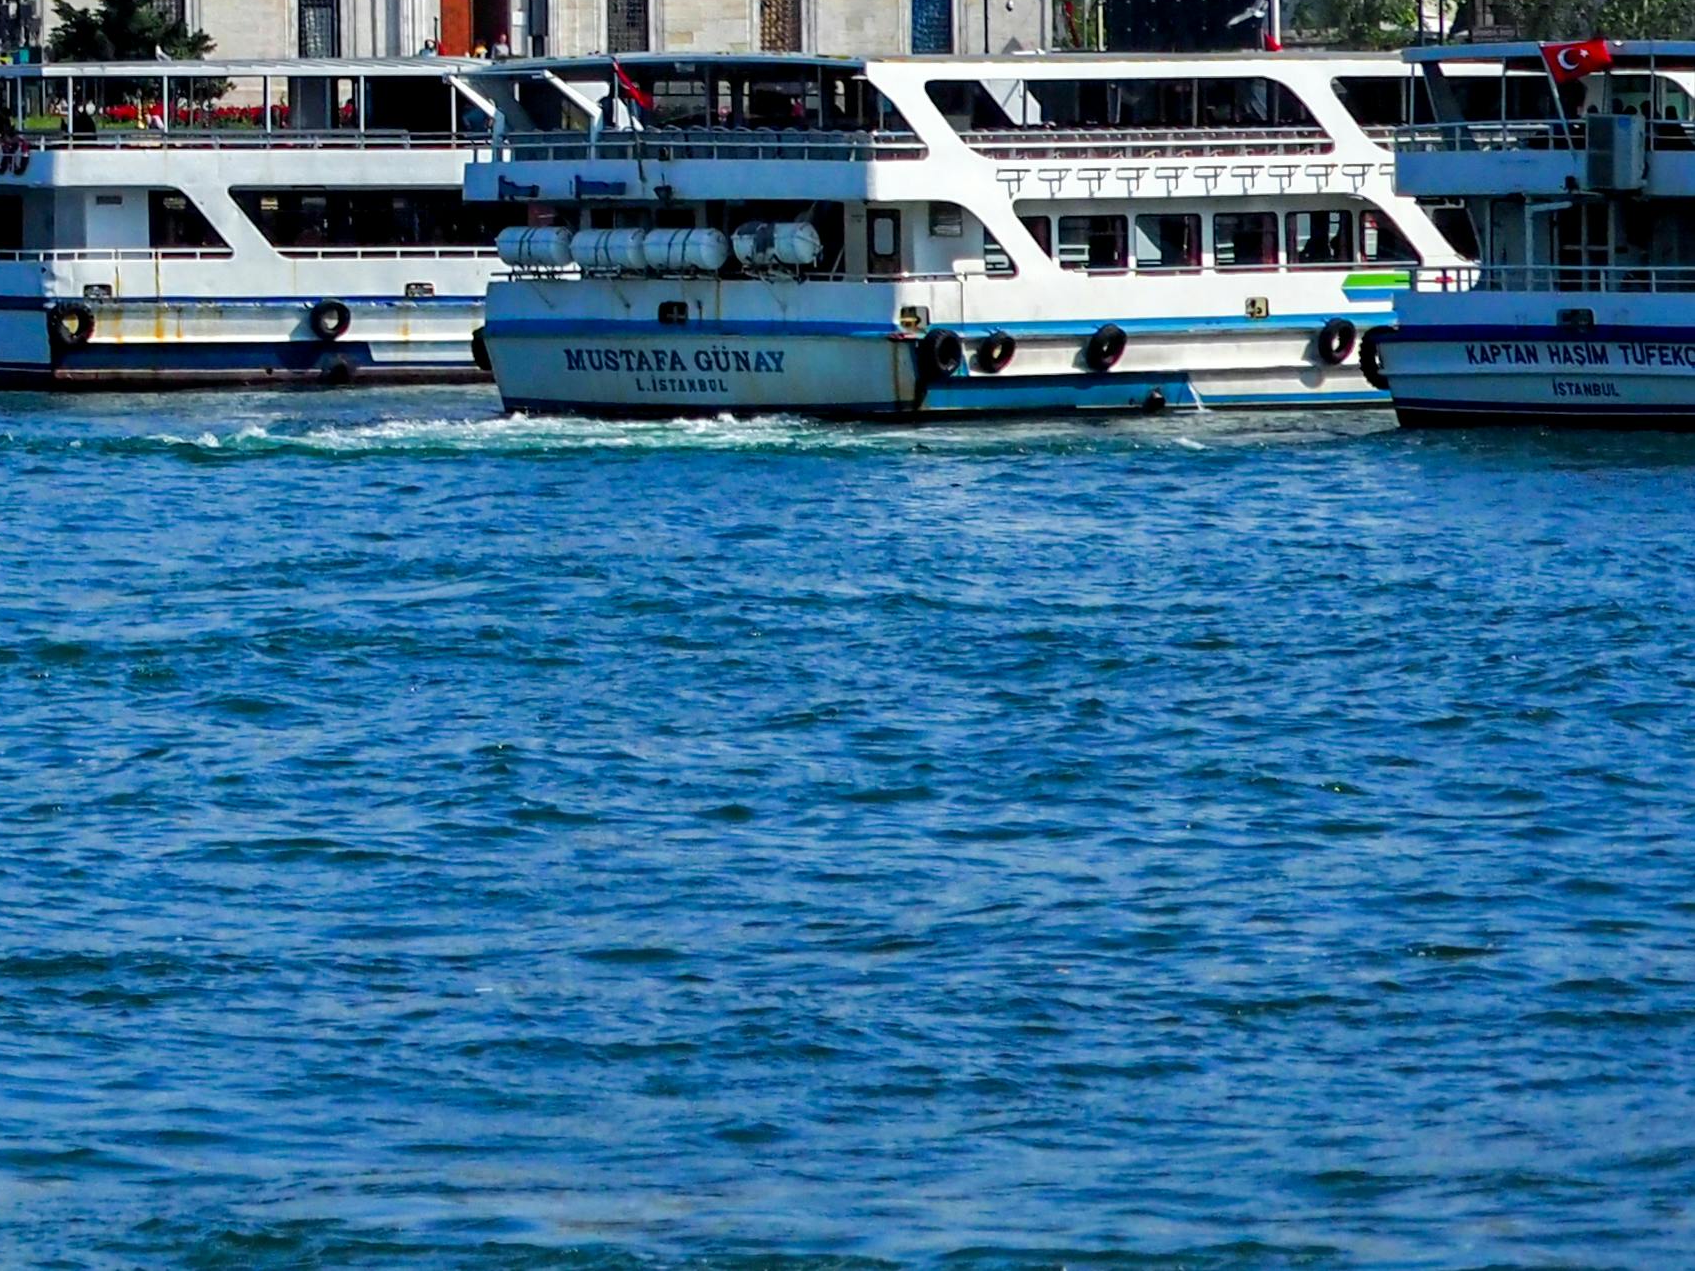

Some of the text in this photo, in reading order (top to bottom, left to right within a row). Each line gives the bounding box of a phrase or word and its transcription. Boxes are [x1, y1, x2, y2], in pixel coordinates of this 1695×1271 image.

[563, 345, 785, 374] MUSTAFA GÜNAY
[1465, 344, 1539, 365] KAPTAN
[1552, 377, 1621, 397] İSTANBUL
